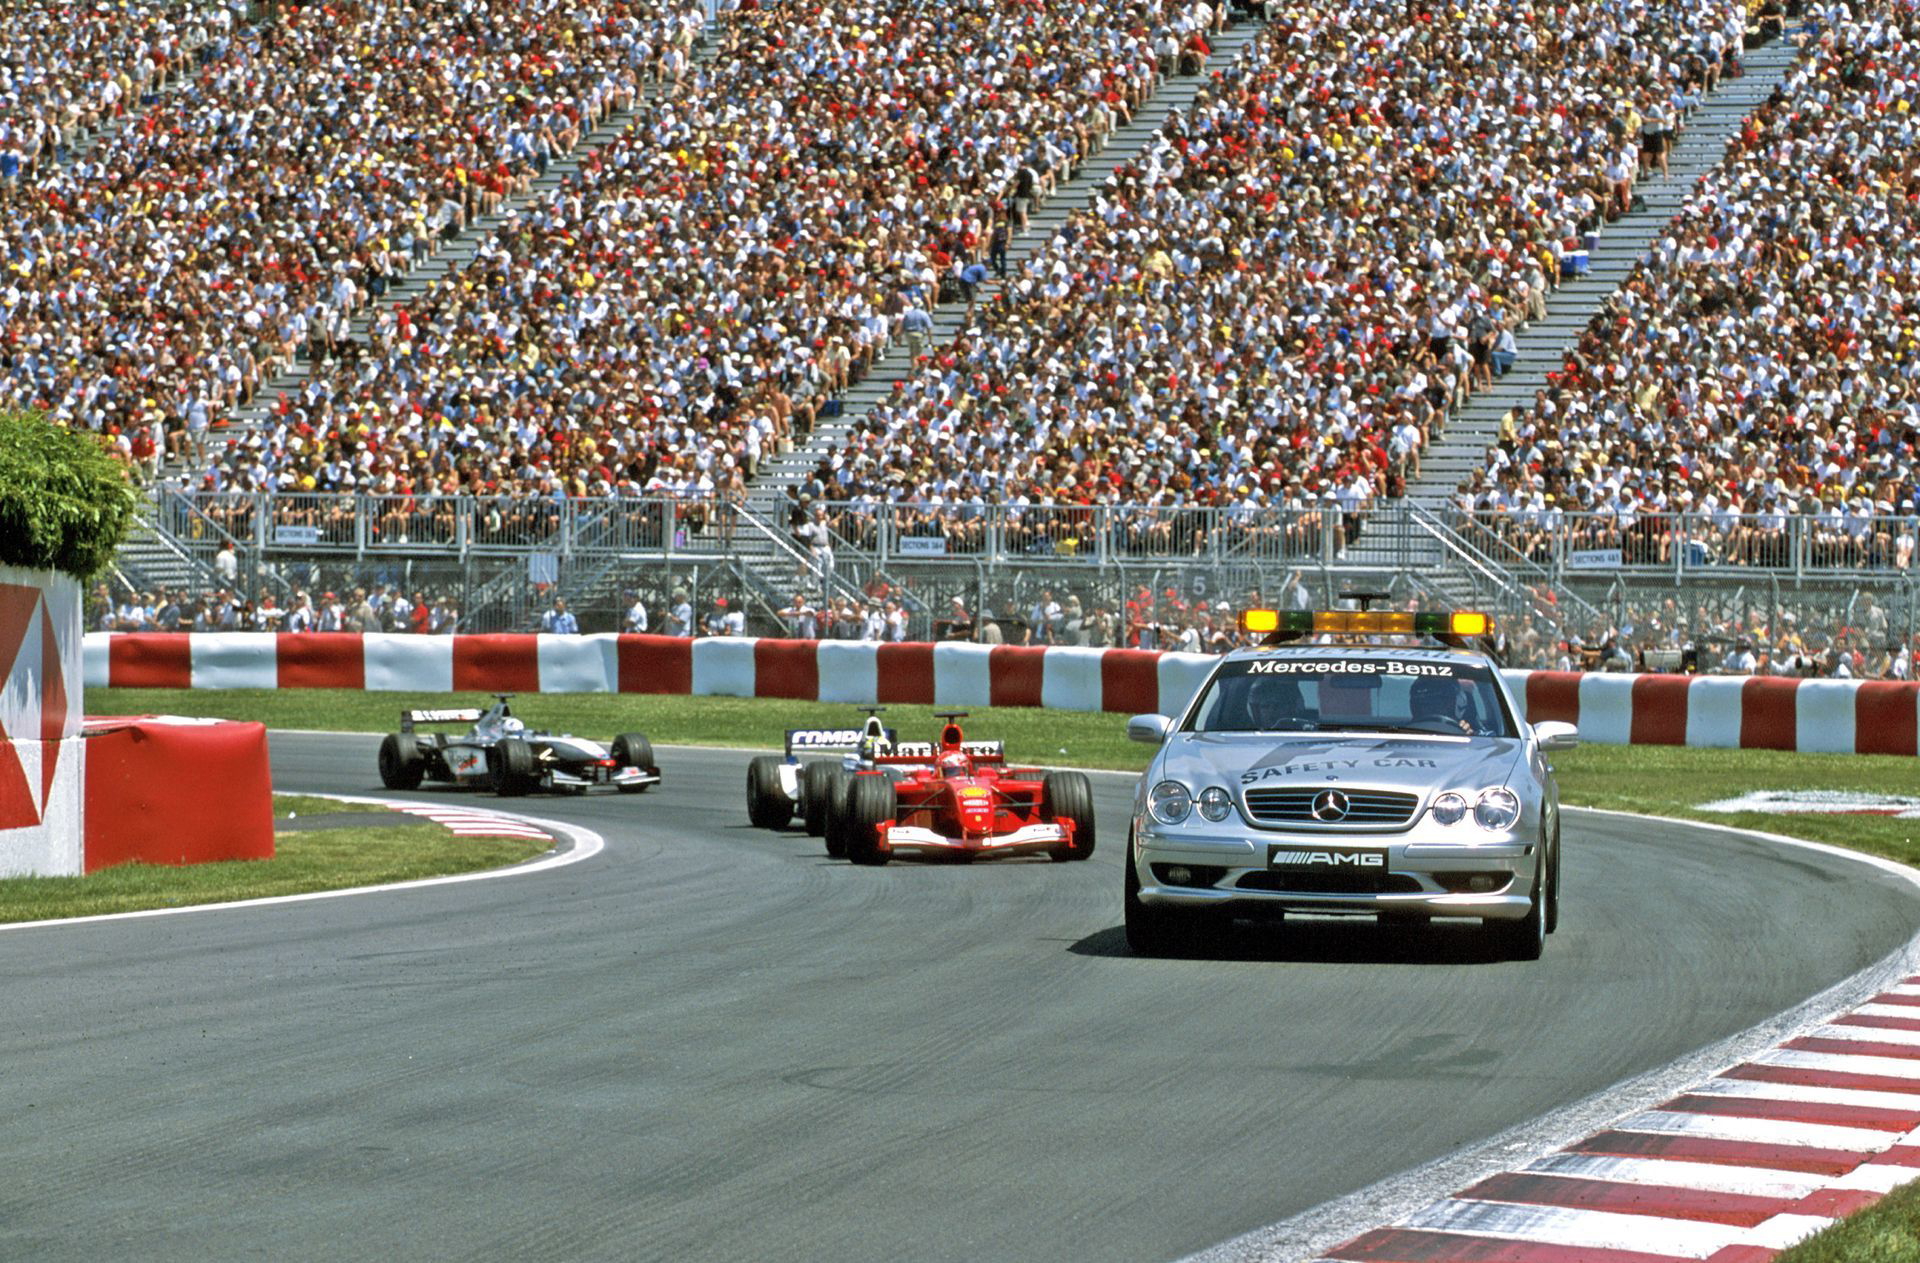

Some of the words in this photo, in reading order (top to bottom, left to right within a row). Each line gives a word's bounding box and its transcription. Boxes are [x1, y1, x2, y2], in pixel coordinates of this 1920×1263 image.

[902, 540, 929, 549] SECTIONS
[1575, 554, 1605, 564] SECTIONS
[1192, 576, 1207, 595] 5
[1247, 660, 1453, 677] Mercedes-Benz
[1240, 759, 1359, 785] SAFETY
[1373, 758, 1437, 769] CAR
[1306, 851, 1384, 866] AMG
